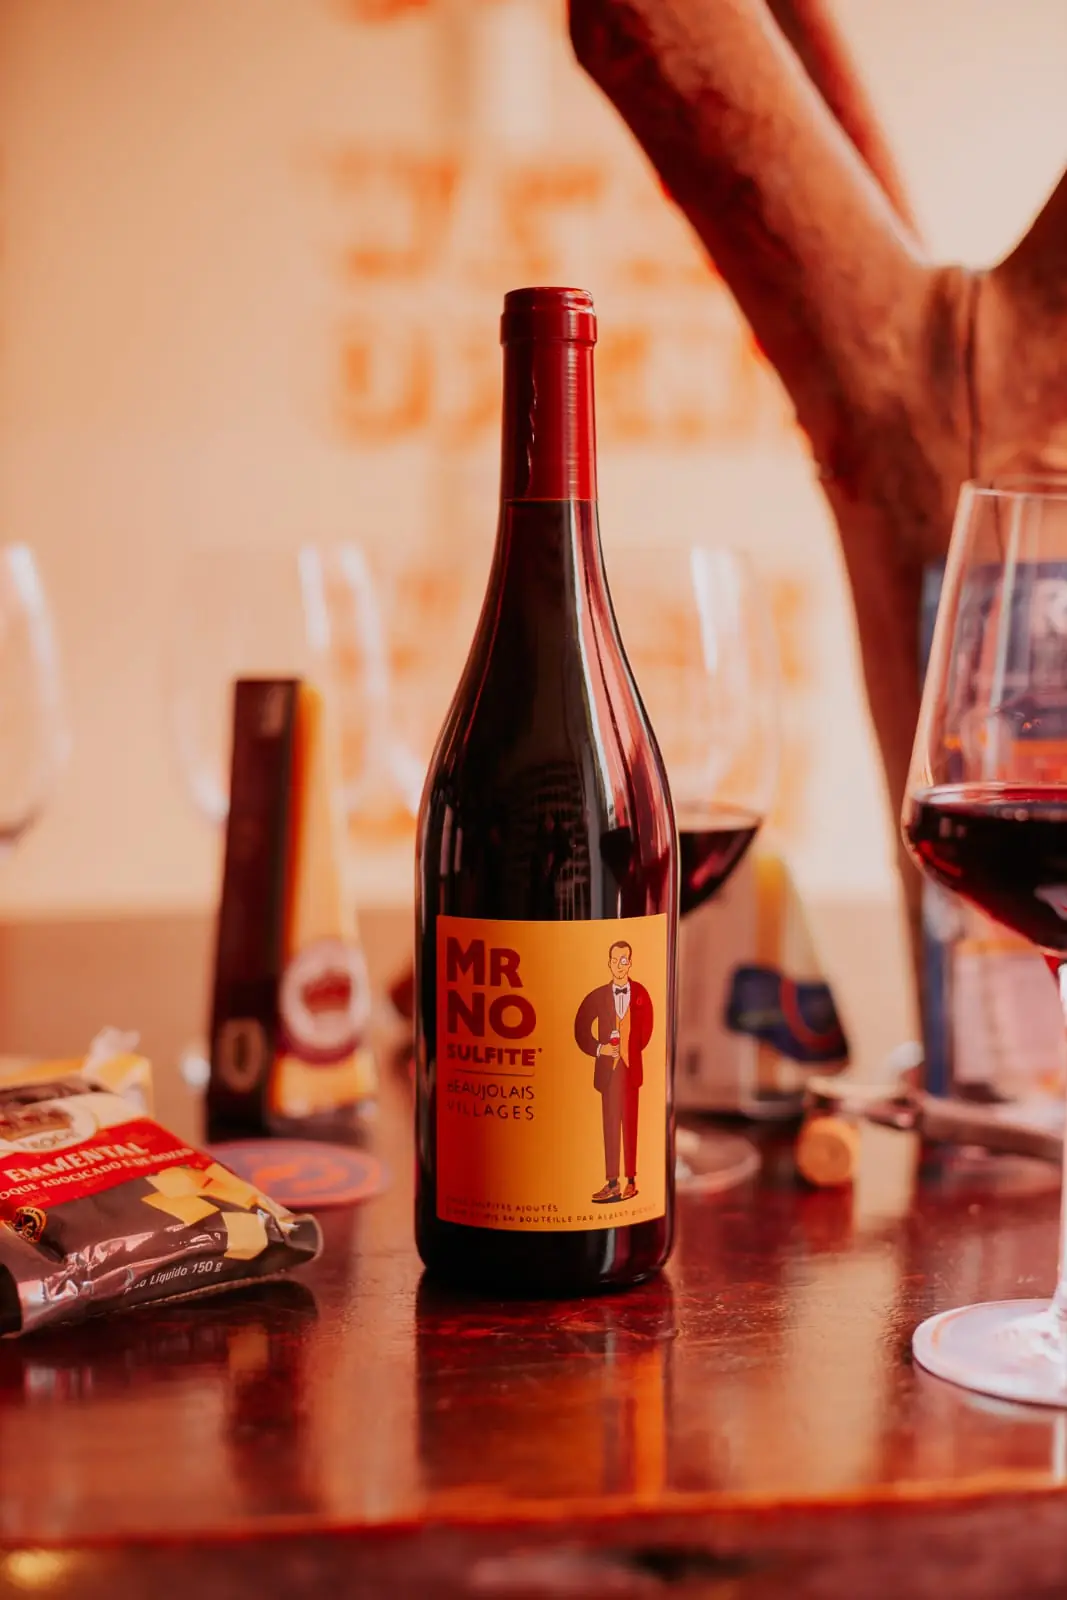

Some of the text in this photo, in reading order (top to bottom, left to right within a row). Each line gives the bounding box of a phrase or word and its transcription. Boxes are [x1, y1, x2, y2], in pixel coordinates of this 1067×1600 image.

[446, 936, 524, 989] MR
[446, 990, 537, 1040] NO
[446, 1078, 535, 1101] BEAUJOLAIS
[446, 1100, 535, 1121] VILLAGES
[3, 1142, 149, 1183] EMMENTAL
[41, 1161, 122, 1188] ADOCICADO
[515, 1202, 559, 1214] AJOUTÉS
[519, 1213, 573, 1223] BOUTEILLE
[150, 1260, 223, 1286] Líquido 150 g
